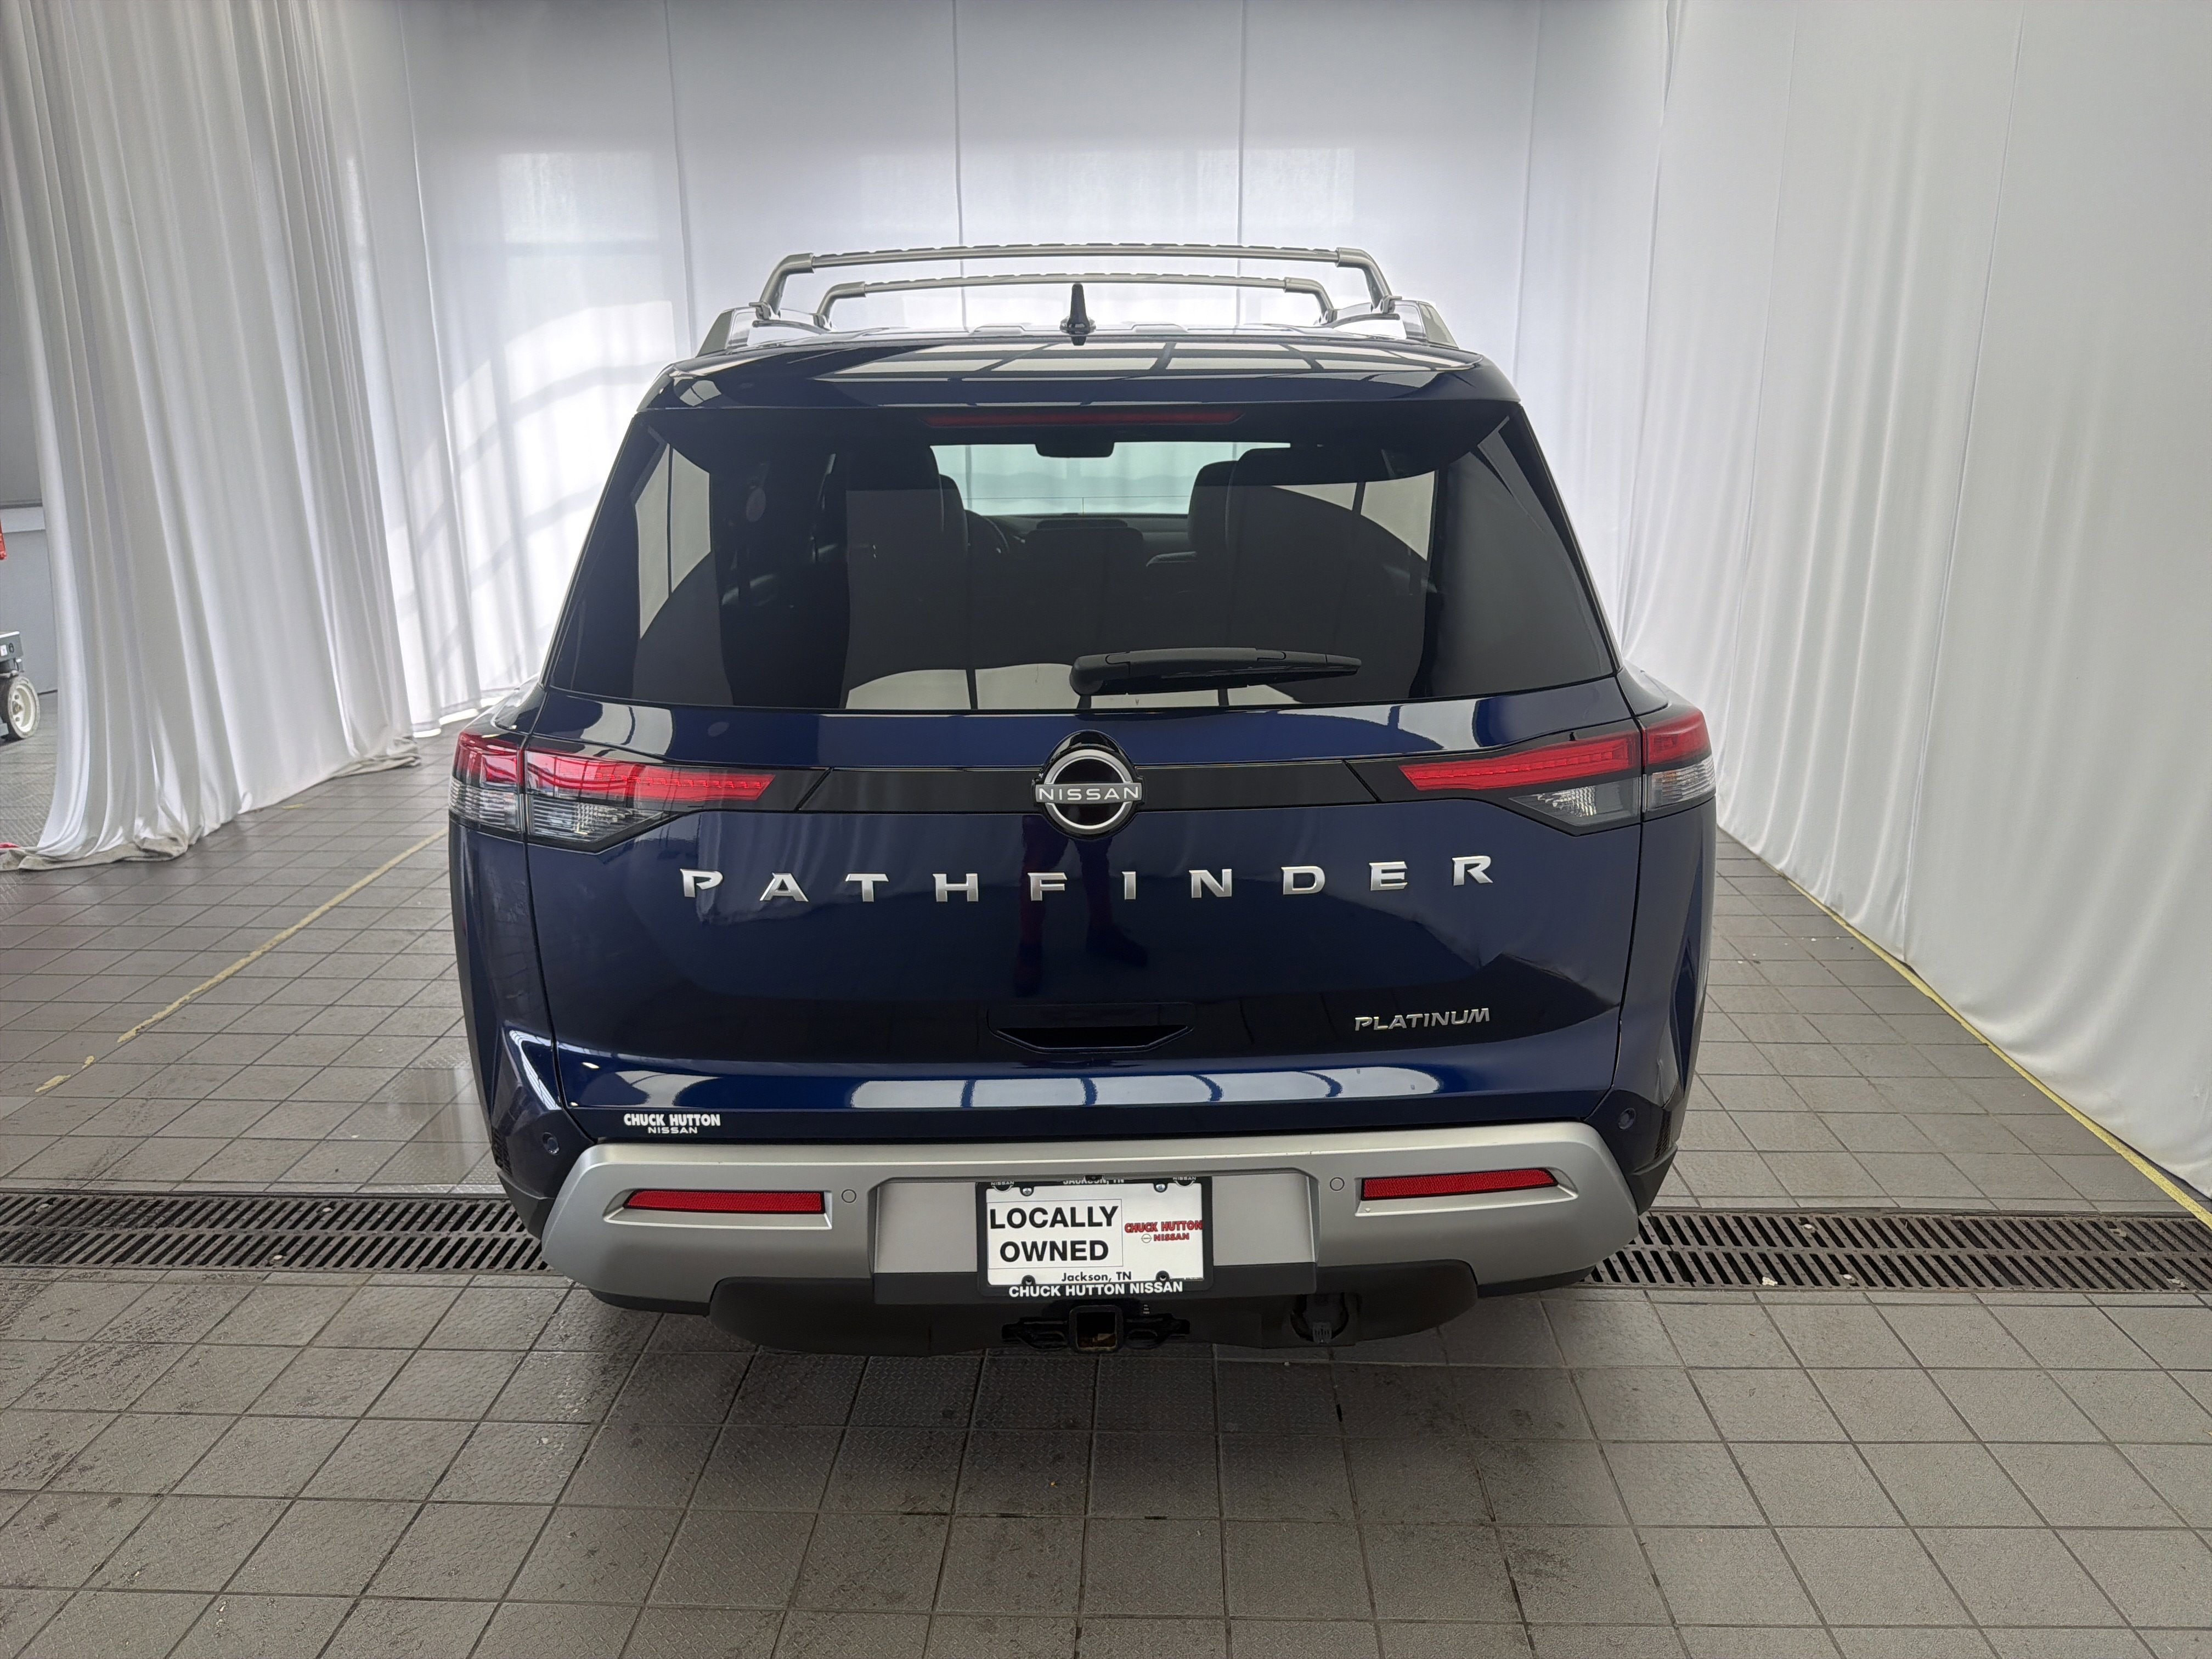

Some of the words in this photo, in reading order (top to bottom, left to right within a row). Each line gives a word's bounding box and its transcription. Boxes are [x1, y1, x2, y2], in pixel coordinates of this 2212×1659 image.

[1039, 786, 1139, 800] NISSAN
[680, 855, 1494, 902] PATHFINDER
[1355, 1007, 1490, 1031] PLATINUM
[623, 1113, 666, 1126] CHUCK
[669, 1113, 721, 1126] HUTTON
[990, 1205, 1119, 1229] LOCALLY
[1124, 1222, 1158, 1233] CHUCK
[1160, 1220, 1203, 1232] HUTTON
[1153, 1232, 1190, 1242] NISSAN
[1000, 1239, 1109, 1263] OWNED
[1061, 1272, 1112, 1283] Jackson,
[1115, 1271, 1132, 1281] TN
[1008, 1285, 1061, 1297] CHUCK
[1065, 1283, 1125, 1296] HUTTON
[1129, 1281, 1183, 1294] NISSAN
